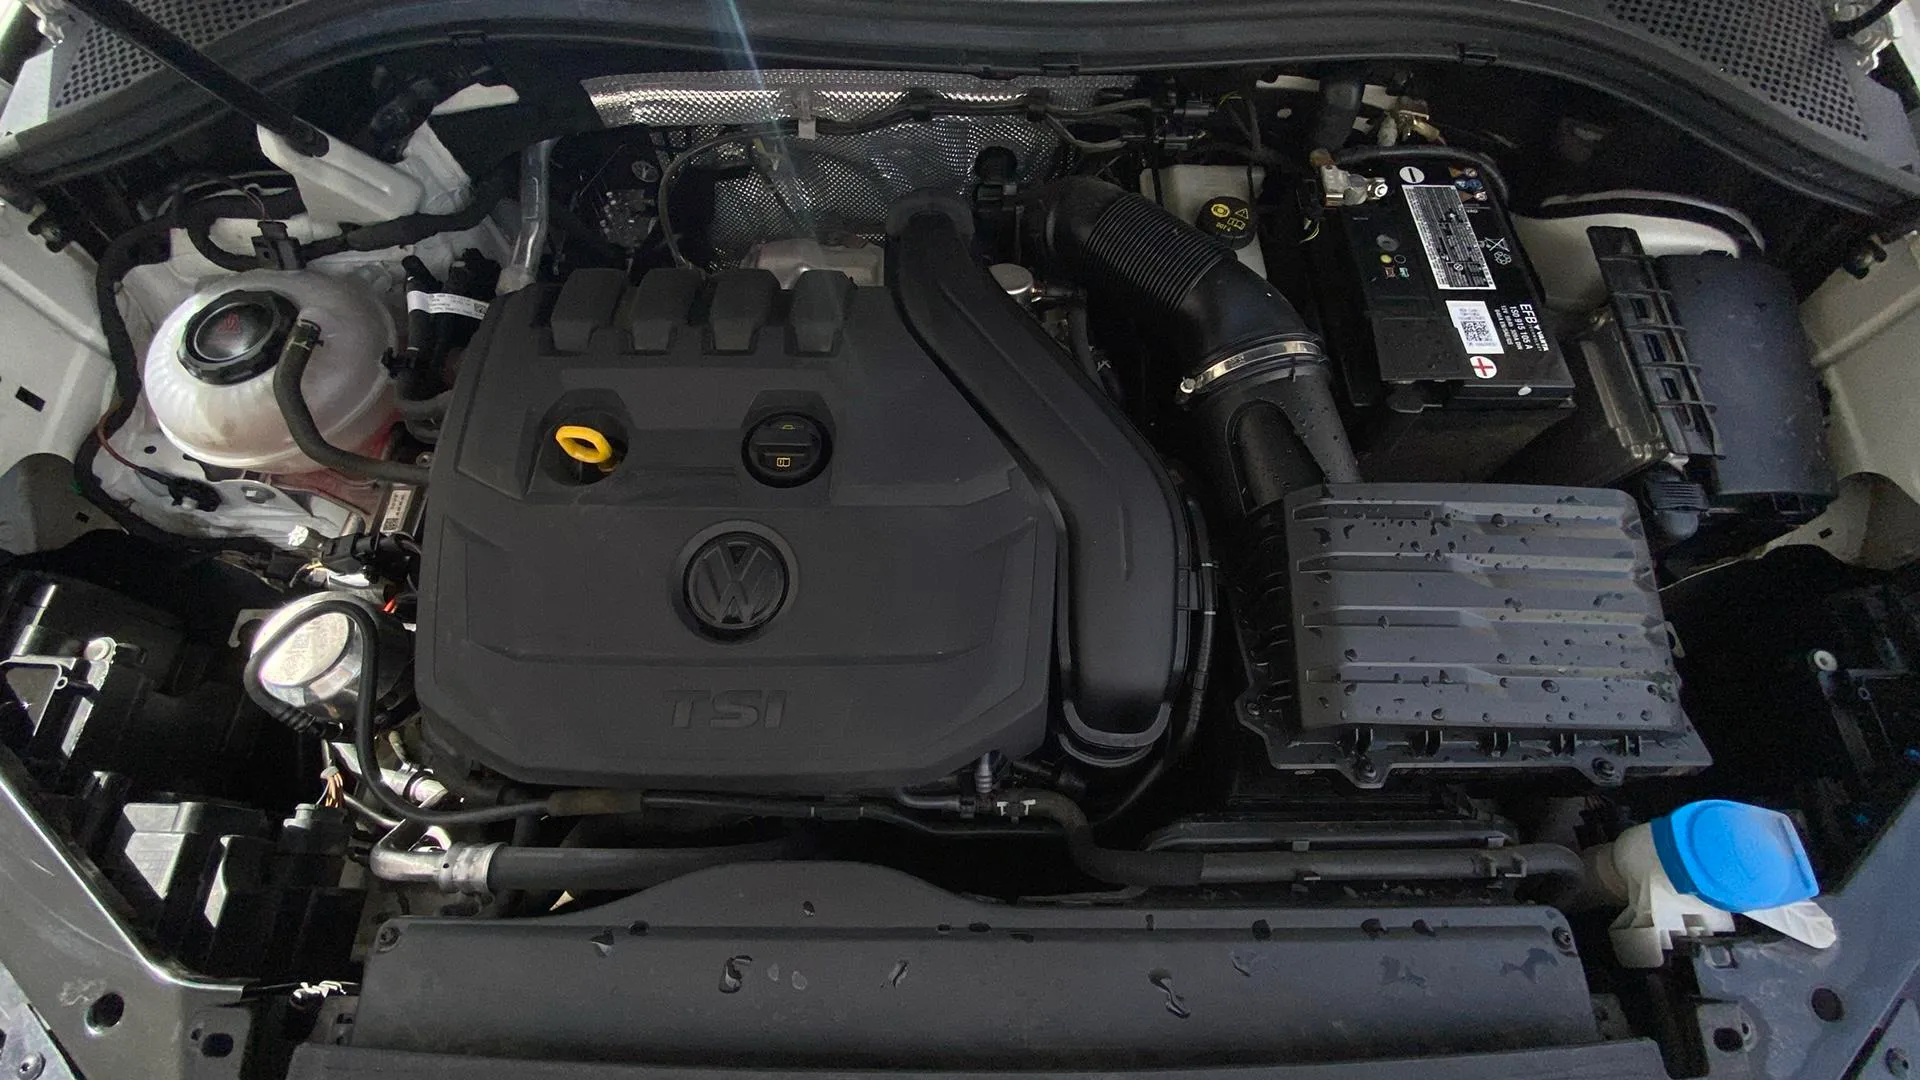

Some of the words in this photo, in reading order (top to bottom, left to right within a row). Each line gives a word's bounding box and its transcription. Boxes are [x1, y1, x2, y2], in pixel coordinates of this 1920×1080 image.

[1515, 318, 1526, 330] 915
[1519, 304, 1538, 323] EFB
[1536, 330, 1549, 351] VARTA
[1520, 332, 1531, 343] 105
[663, 690, 788, 729] TSI
